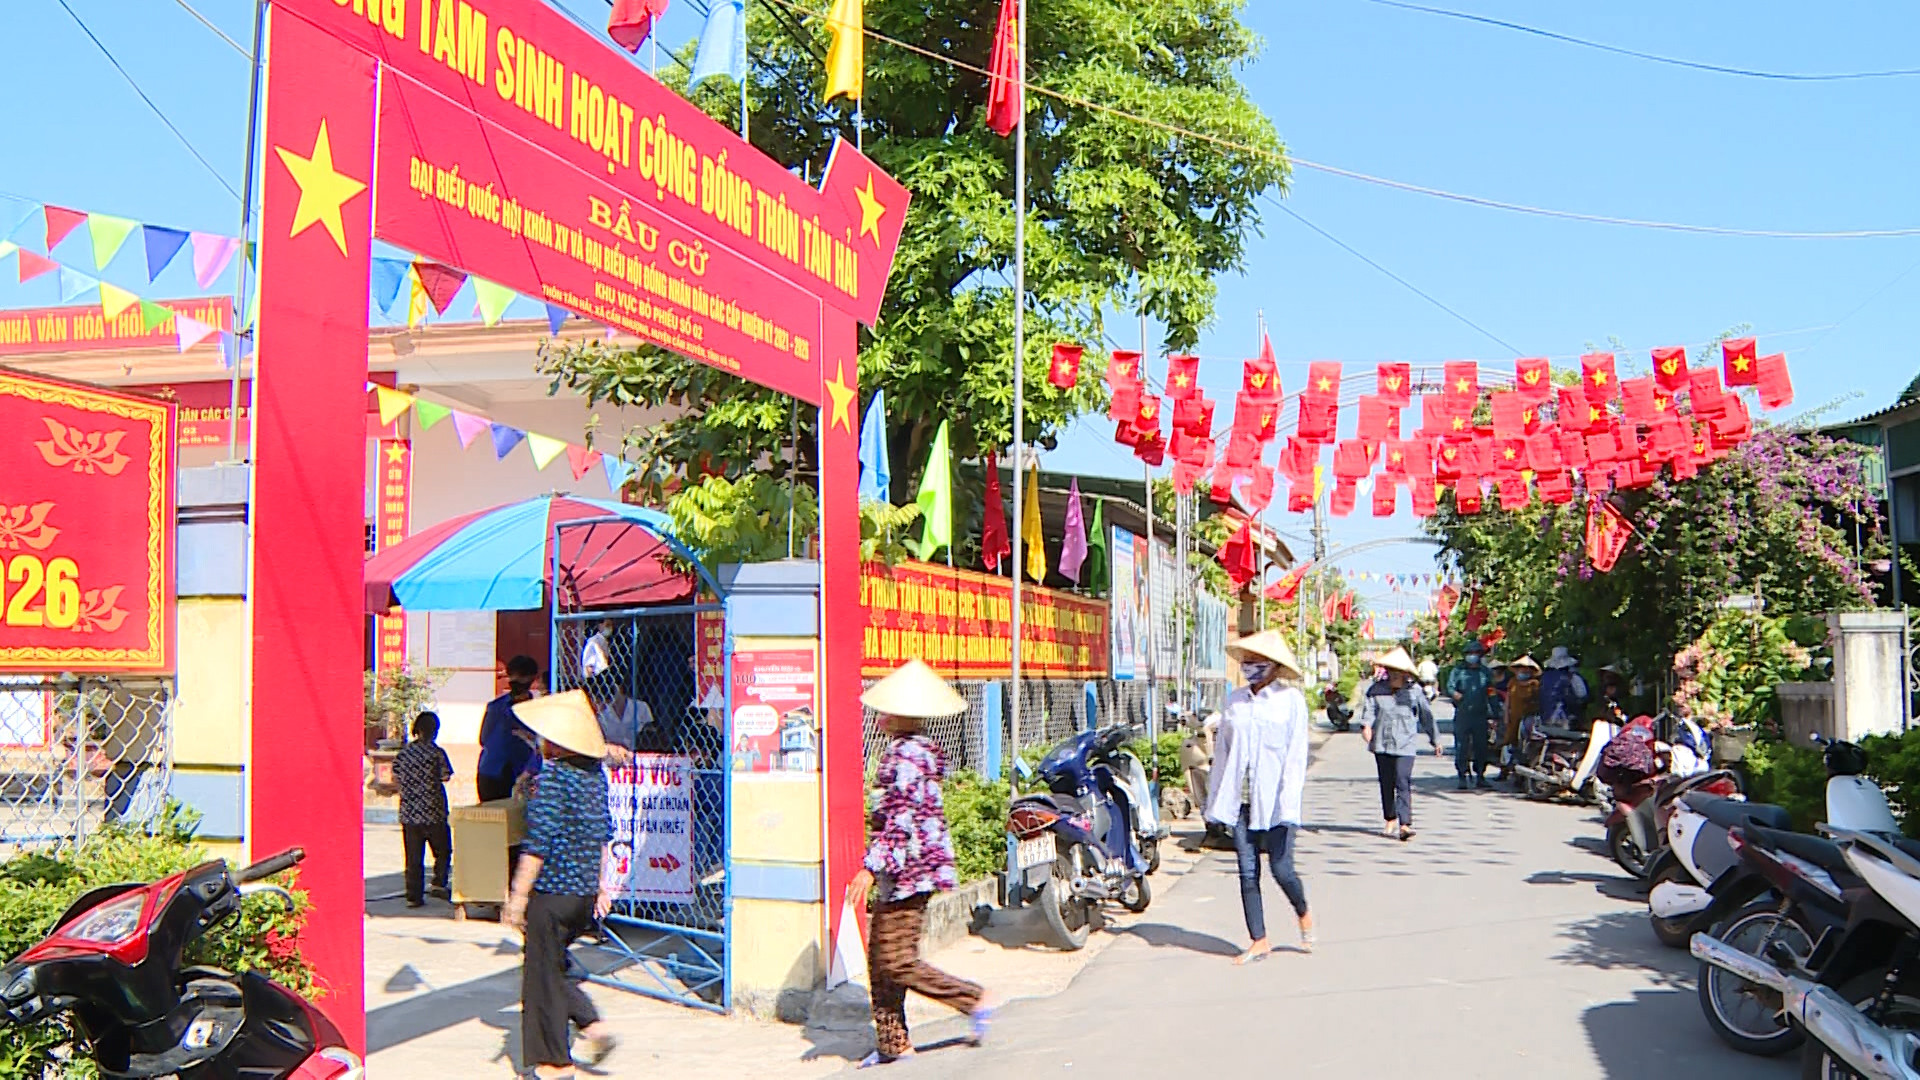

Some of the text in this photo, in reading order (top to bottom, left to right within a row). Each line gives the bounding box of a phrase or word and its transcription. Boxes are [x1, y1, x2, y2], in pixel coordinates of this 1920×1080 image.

[495, 26, 564, 130] SINH
[571, 71, 634, 175] HOẠT
[639, 113, 697, 206] CỘNG
[701, 147, 752, 237] ĐỒNG
[757, 189, 799, 264] THÔN
[803, 214, 832, 283] TÂN
[835, 226, 858, 299] HẢI
[410, 155, 434, 199] ĐẠI
[436, 163, 466, 209] BIỂU
[467, 182, 500, 224] QUỐC
[502, 197, 522, 238] HỘI
[524, 210, 553, 248] KHÓA
[555, 222, 569, 254] XV
[570, 227, 584, 262] VÀ
[585, 237, 602, 273] ĐẠI
[626, 255, 642, 290] HỘI
[692, 285, 709, 317] DÂN
[709, 294, 725, 324] CÁC
[589, 195, 709, 277] BẦU CỬ
[0, 313, 32, 344] NHÀ
[37, 312, 68, 343] VĂN
[74, 309, 105, 340] HÓA
[595, 281, 616, 304] KHU
[639, 297, 652, 320] BỎ
[653, 307, 679, 331] PHIẾU
[679, 315, 692, 336] SỐ
[692, 323, 704, 341] 02
[864, 621, 880, 660] VÀ
[881, 629, 900, 666] ĐẠI
[901, 620, 924, 660] BIỂU
[924, 628, 941, 667] HỘI
